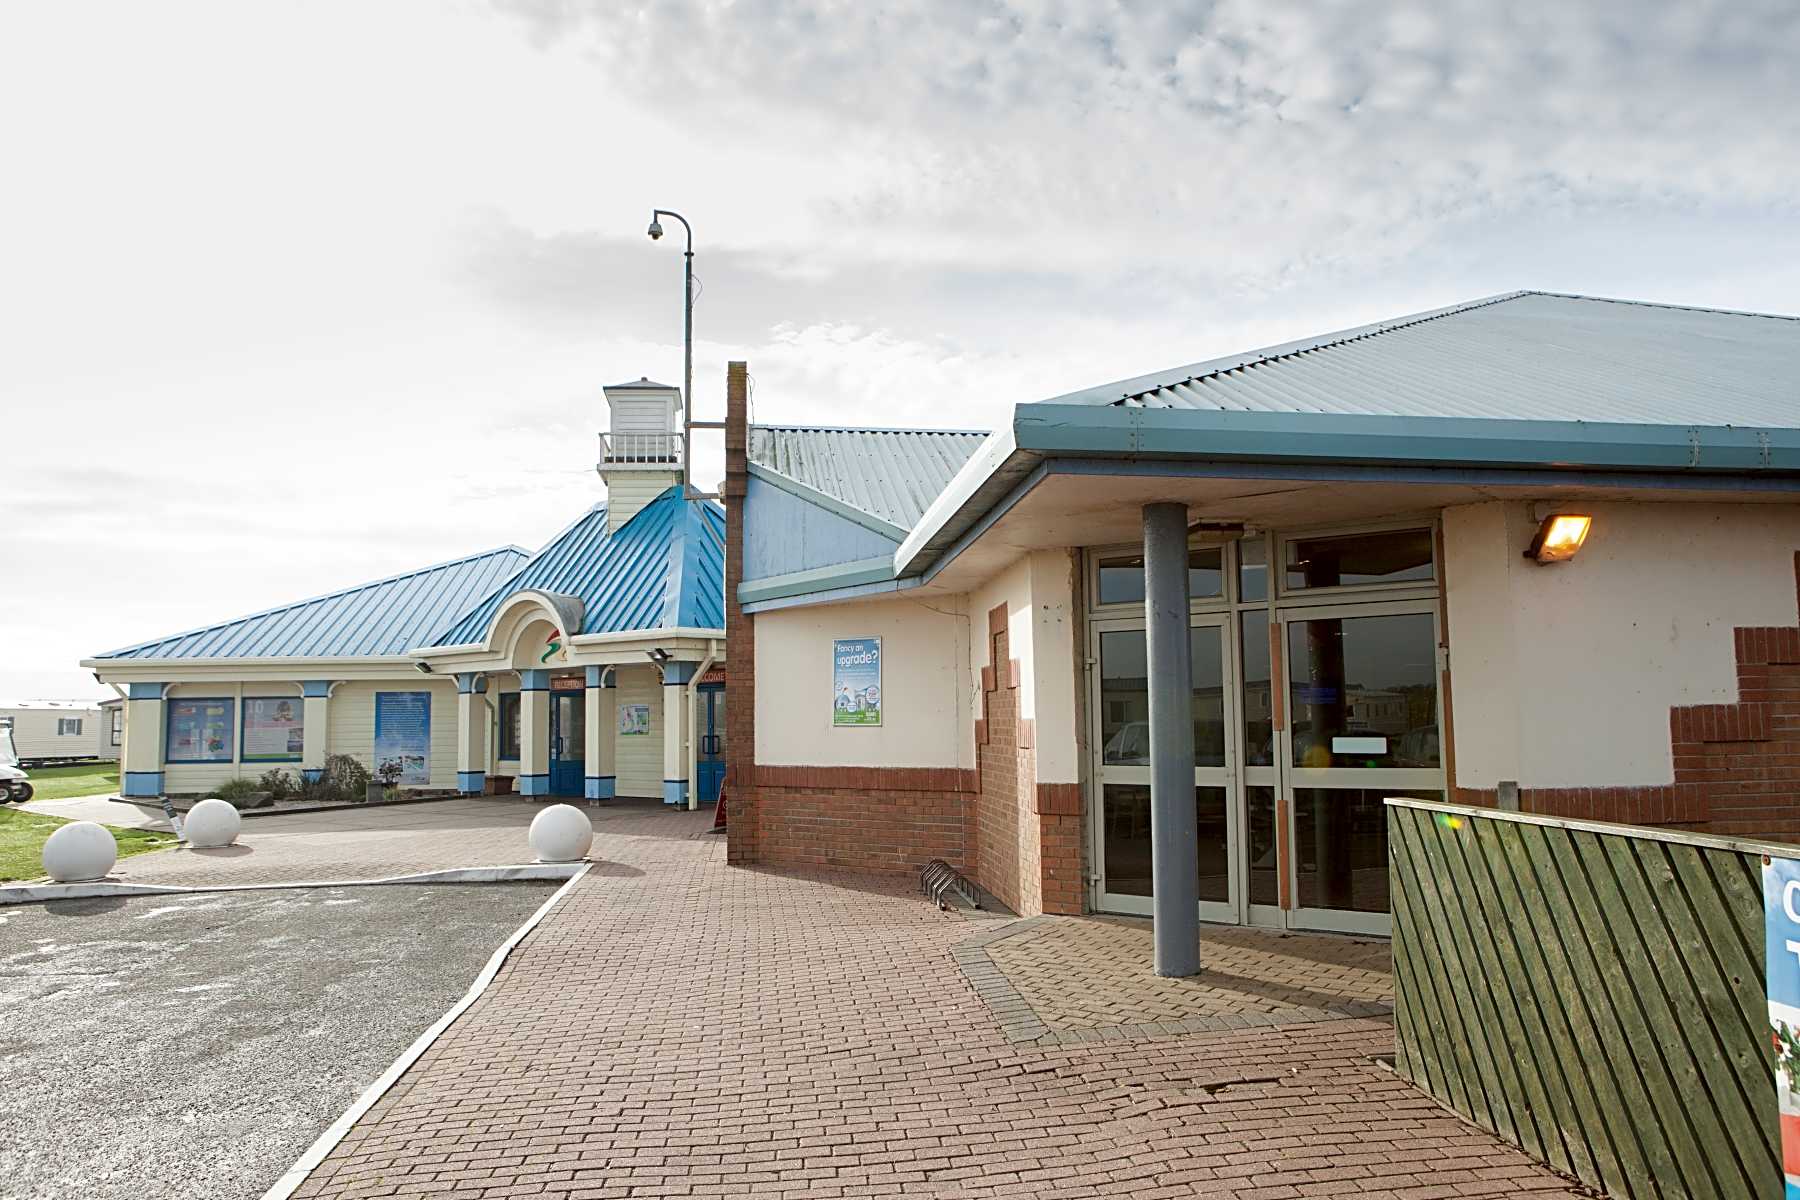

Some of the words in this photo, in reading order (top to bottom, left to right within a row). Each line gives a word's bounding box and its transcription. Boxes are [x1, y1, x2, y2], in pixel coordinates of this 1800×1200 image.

[837, 644, 854, 654] Fancy
[837, 650, 878, 667] upgrade?
[701, 671, 725, 682] COME
